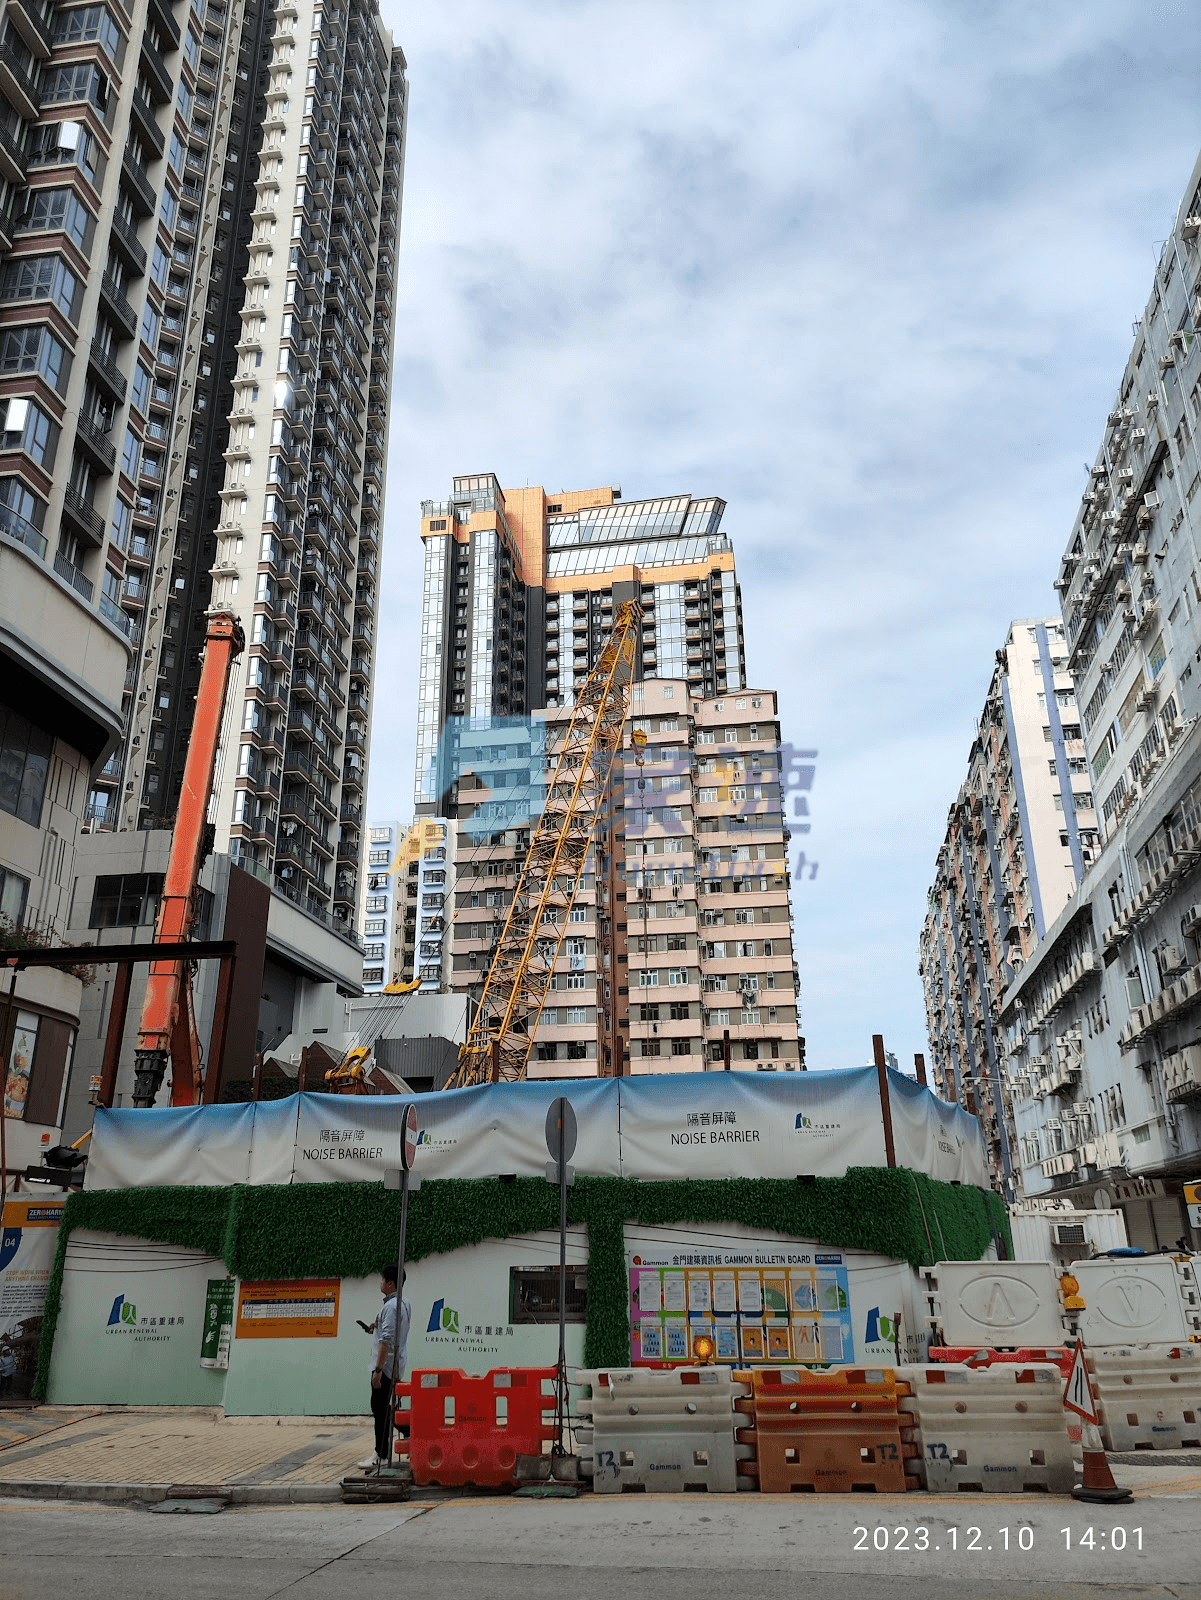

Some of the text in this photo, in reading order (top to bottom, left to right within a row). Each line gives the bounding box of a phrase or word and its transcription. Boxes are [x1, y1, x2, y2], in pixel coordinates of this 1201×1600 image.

[686, 1110, 737, 1127] 隔音屏障
[319, 1129, 366, 1143] 隔音屏障
[670, 1130, 760, 1145] NOISE BARRIER
[303, 1147, 383, 1161] NOISE BARRIER
[4, 1237, 16, 1248] 04
[672, 1254, 723, 1266] 金門建築資訊板
[724, 1255, 811, 1265] GAMMON BULLETIN BOARD
[140, 1316, 185, 1326] 市區重建局
[464, 1325, 514, 1336] 市區重建局
[876, 1443, 899, 1461] T2
[926, 1442, 950, 1460] T2
[595, 1450, 617, 1467] T2
[649, 1463, 682, 1471] Gammon
[983, 1464, 1018, 1473] Gammon
